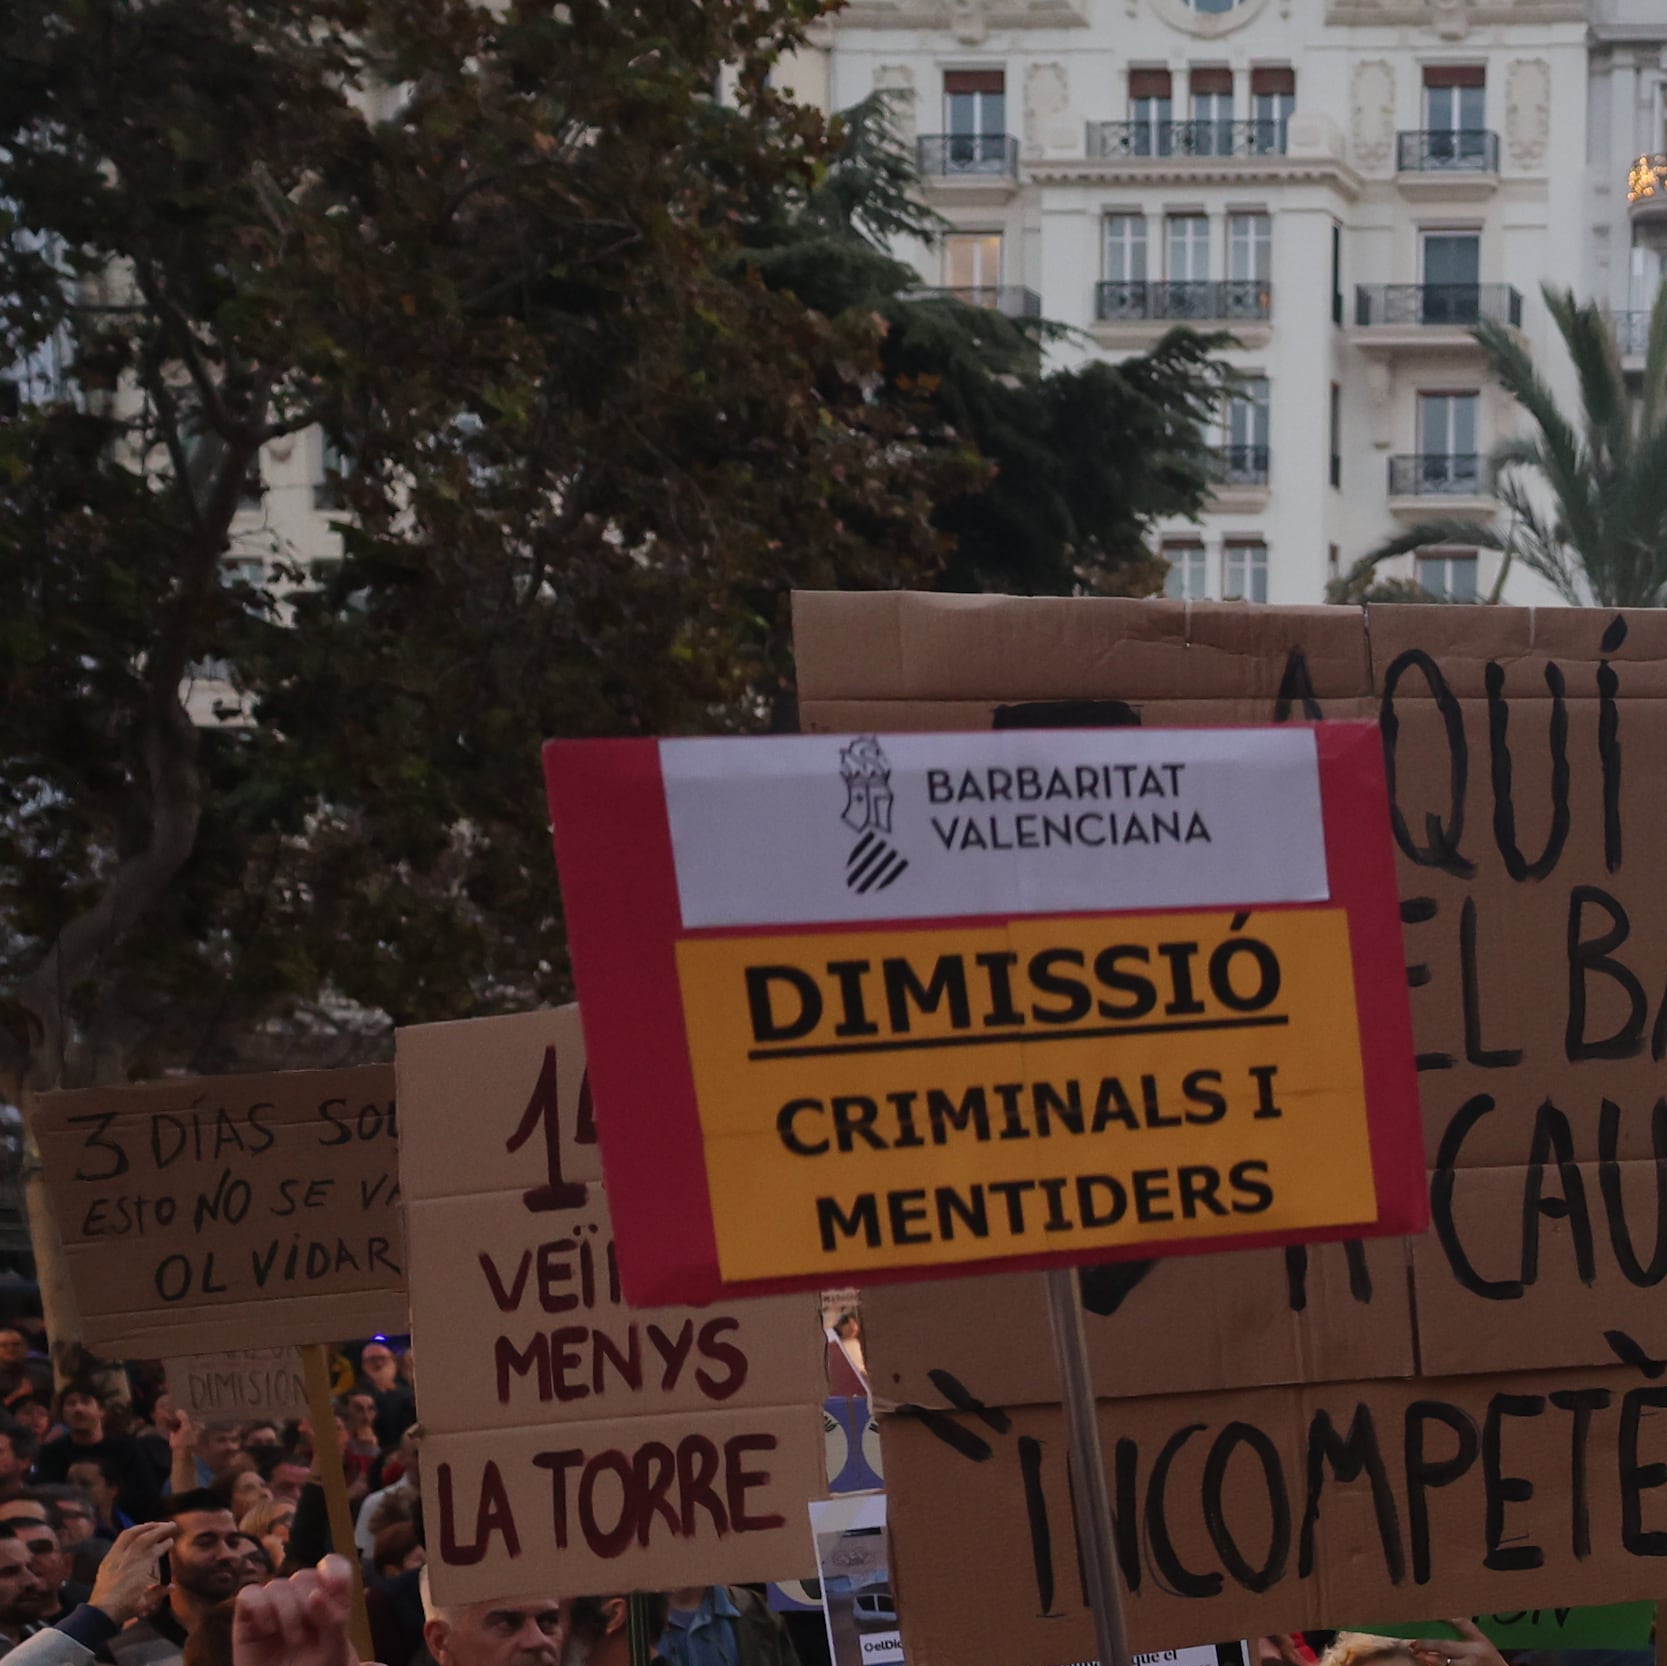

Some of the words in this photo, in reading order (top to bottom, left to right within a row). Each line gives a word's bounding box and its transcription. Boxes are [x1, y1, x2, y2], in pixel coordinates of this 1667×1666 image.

[926, 764, 1188, 805] BARBARITAT
[931, 811, 1213, 852] VALENCIANA
[744, 912, 1284, 1045] DIMISSIÓ
[67, 1112, 130, 1182] 3
[152, 1096, 276, 1170] DÍAS
[776, 1068, 1229, 1159] CRIMINALS
[1252, 1066, 1283, 1120] I
[82, 1194, 177, 1236] ESTO
[194, 1168, 252, 1234] NO
[270, 1179, 336, 1217] SE
[816, 1159, 1275, 1254] MENTIDERS
[495, 1317, 749, 1404] MENYS
[438, 1459, 523, 1566] LA
[533, 1432, 786, 1559] TORRE
